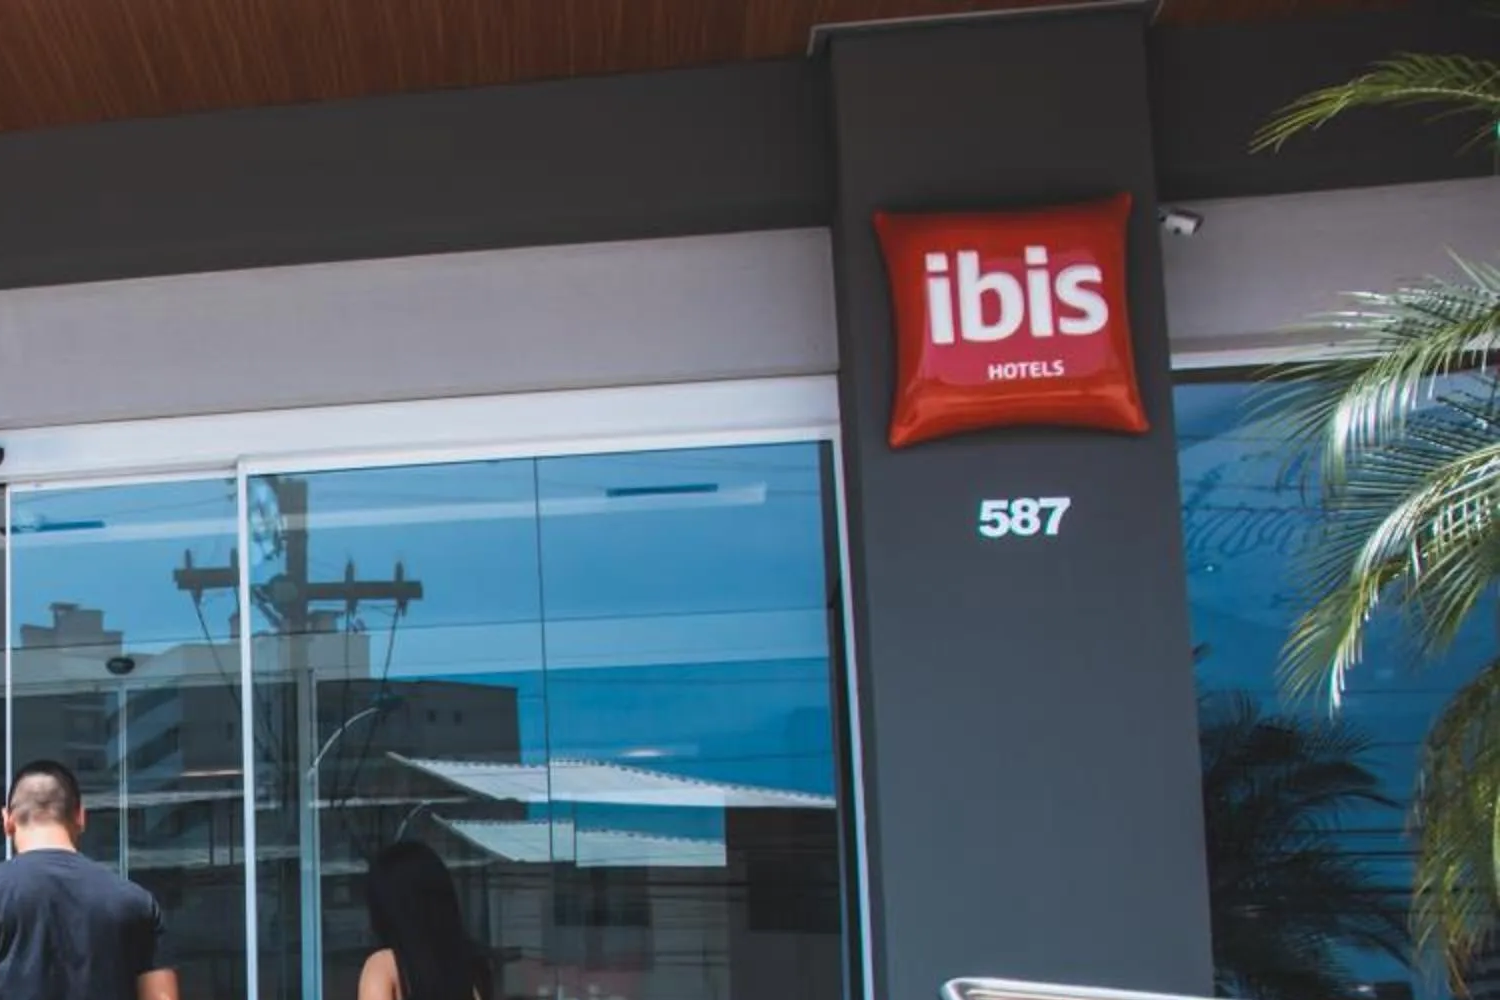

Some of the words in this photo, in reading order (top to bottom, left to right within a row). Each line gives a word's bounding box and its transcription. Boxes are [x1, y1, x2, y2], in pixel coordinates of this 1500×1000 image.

[925, 245, 1109, 344] ibis
[987, 359, 1065, 380] HOTELS
[978, 497, 1071, 537] 587
